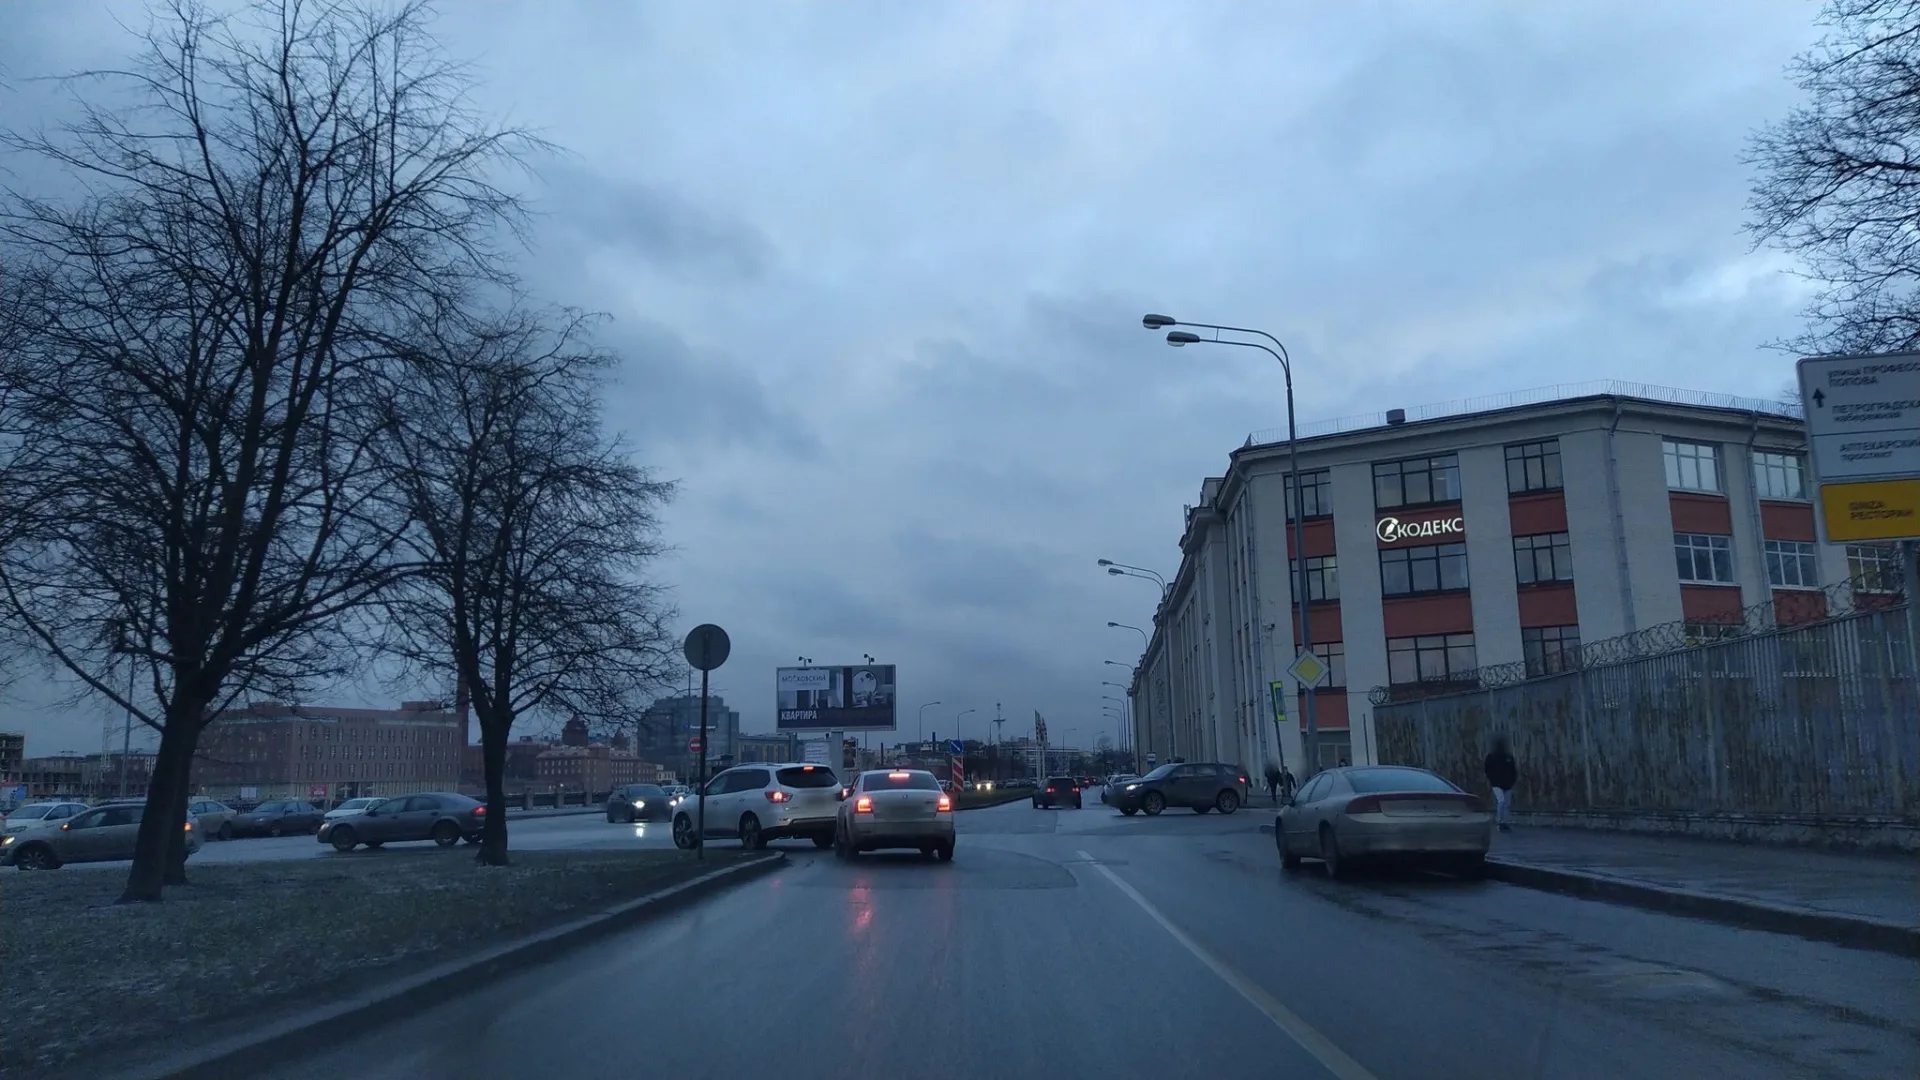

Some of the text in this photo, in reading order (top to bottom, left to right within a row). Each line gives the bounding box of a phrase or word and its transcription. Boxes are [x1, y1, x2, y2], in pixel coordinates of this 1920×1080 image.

[1828, 376, 1879, 388] ПОПОВА
[1840, 451, 1892, 462] проспект
[1397, 517, 1463, 538] КОДЕКС
[781, 710, 818, 721] КВАРТИРА
